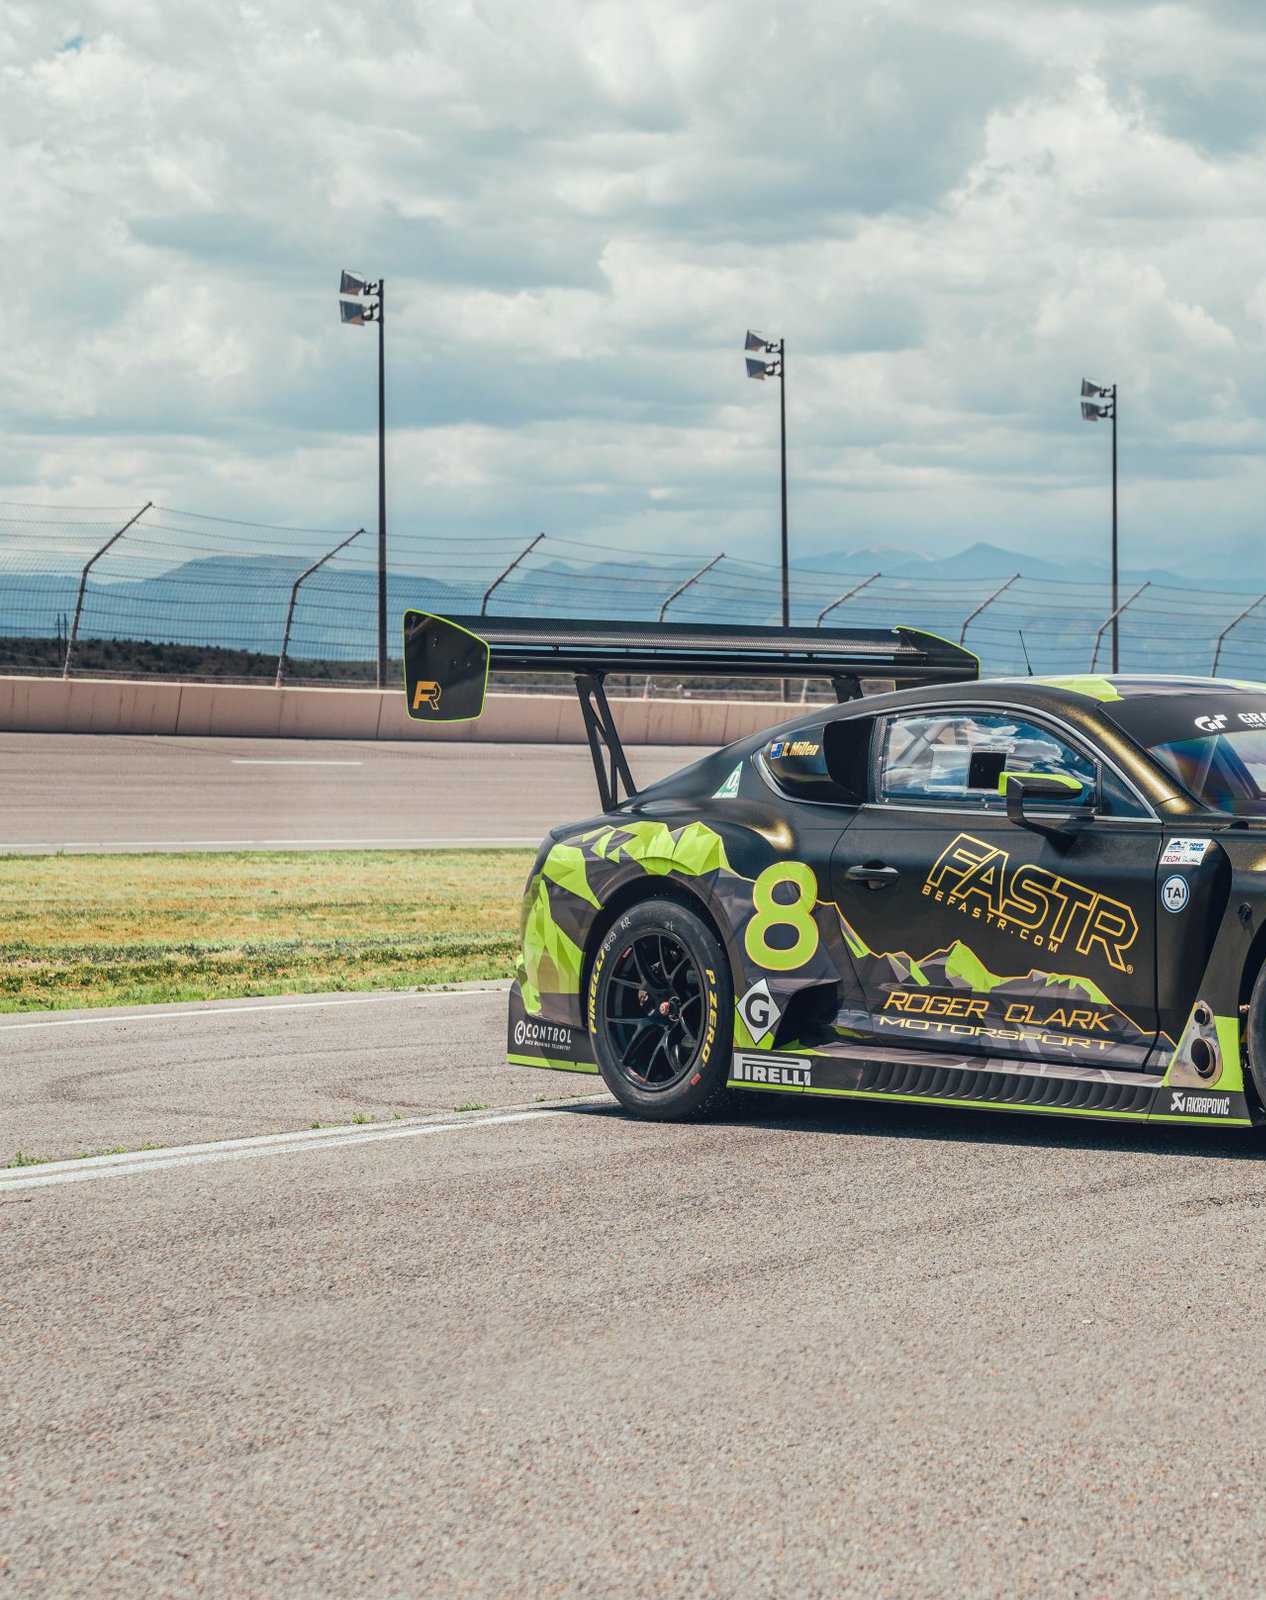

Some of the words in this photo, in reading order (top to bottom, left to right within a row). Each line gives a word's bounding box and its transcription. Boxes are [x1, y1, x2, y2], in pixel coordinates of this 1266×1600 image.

[926, 832, 1139, 972] FASTR
[1166, 887, 1185, 898] TAI
[745, 861, 819, 971] 8
[921, 884, 1060, 954] BEFASTR.COM
[705, 969, 716, 985] P
[701, 990, 718, 1063] ZERO
[745, 992, 770, 1029] G
[883, 991, 990, 1019] ROGER
[1003, 1003, 1116, 1032] CLARK
[526, 1023, 572, 1044] CONTROL
[879, 1015, 1118, 1050] MOTORSPORT
[733, 1052, 812, 1086] PIRELLI
